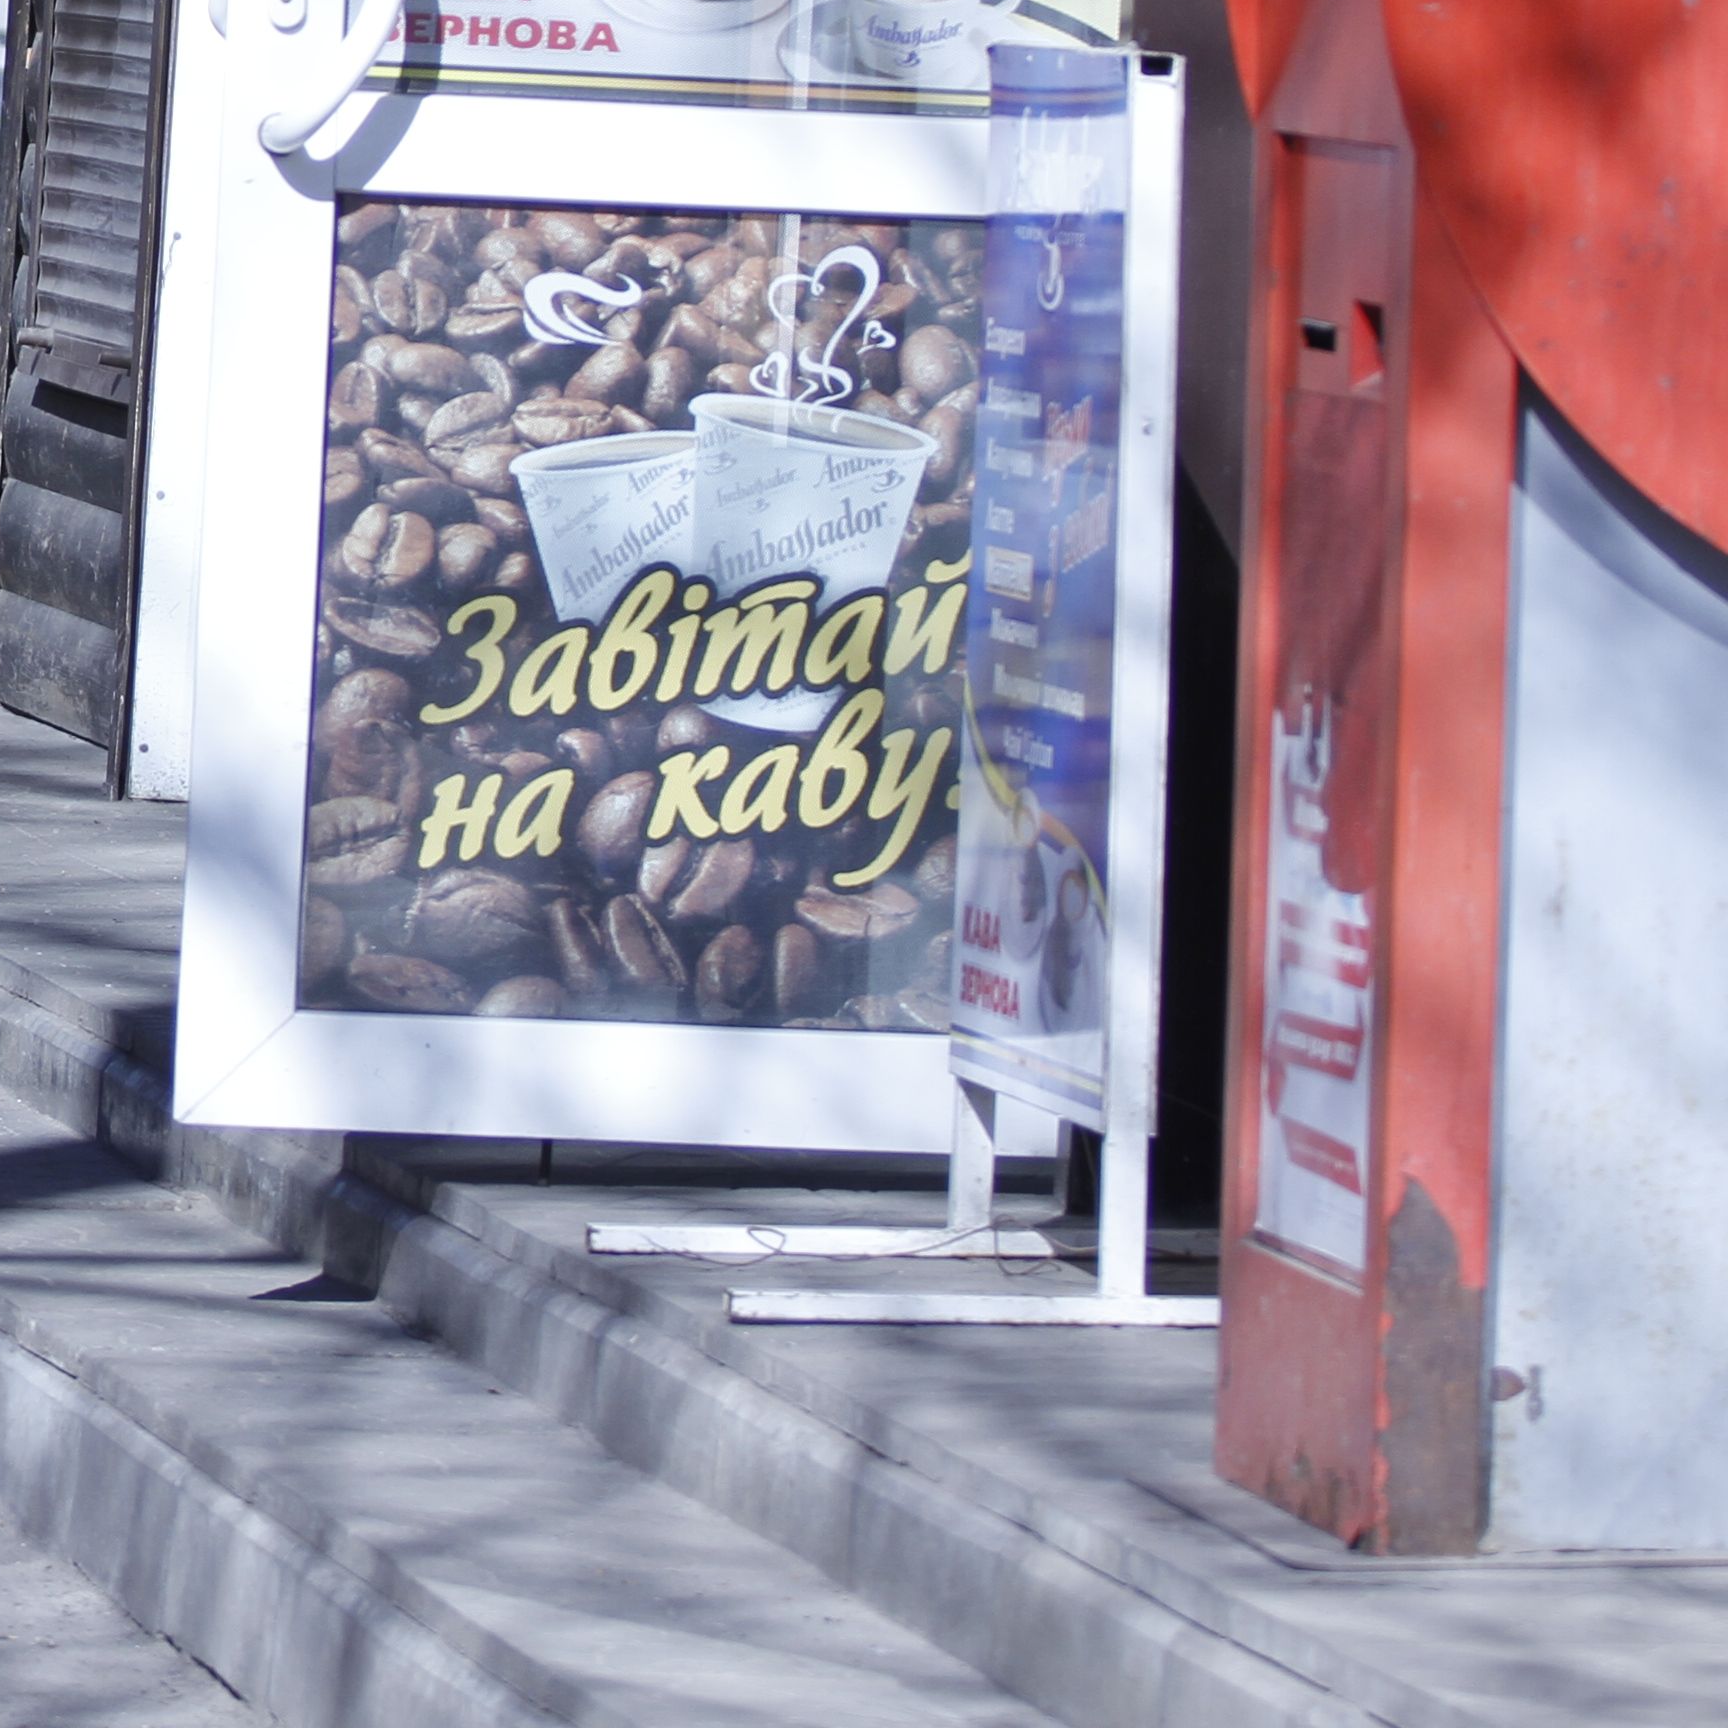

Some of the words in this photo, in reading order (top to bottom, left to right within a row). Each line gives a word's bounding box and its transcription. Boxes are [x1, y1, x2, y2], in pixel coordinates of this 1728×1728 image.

[704, 495, 889, 584] Ambassador
[419, 545, 971, 726] Завітай
[418, 768, 575, 870] на
